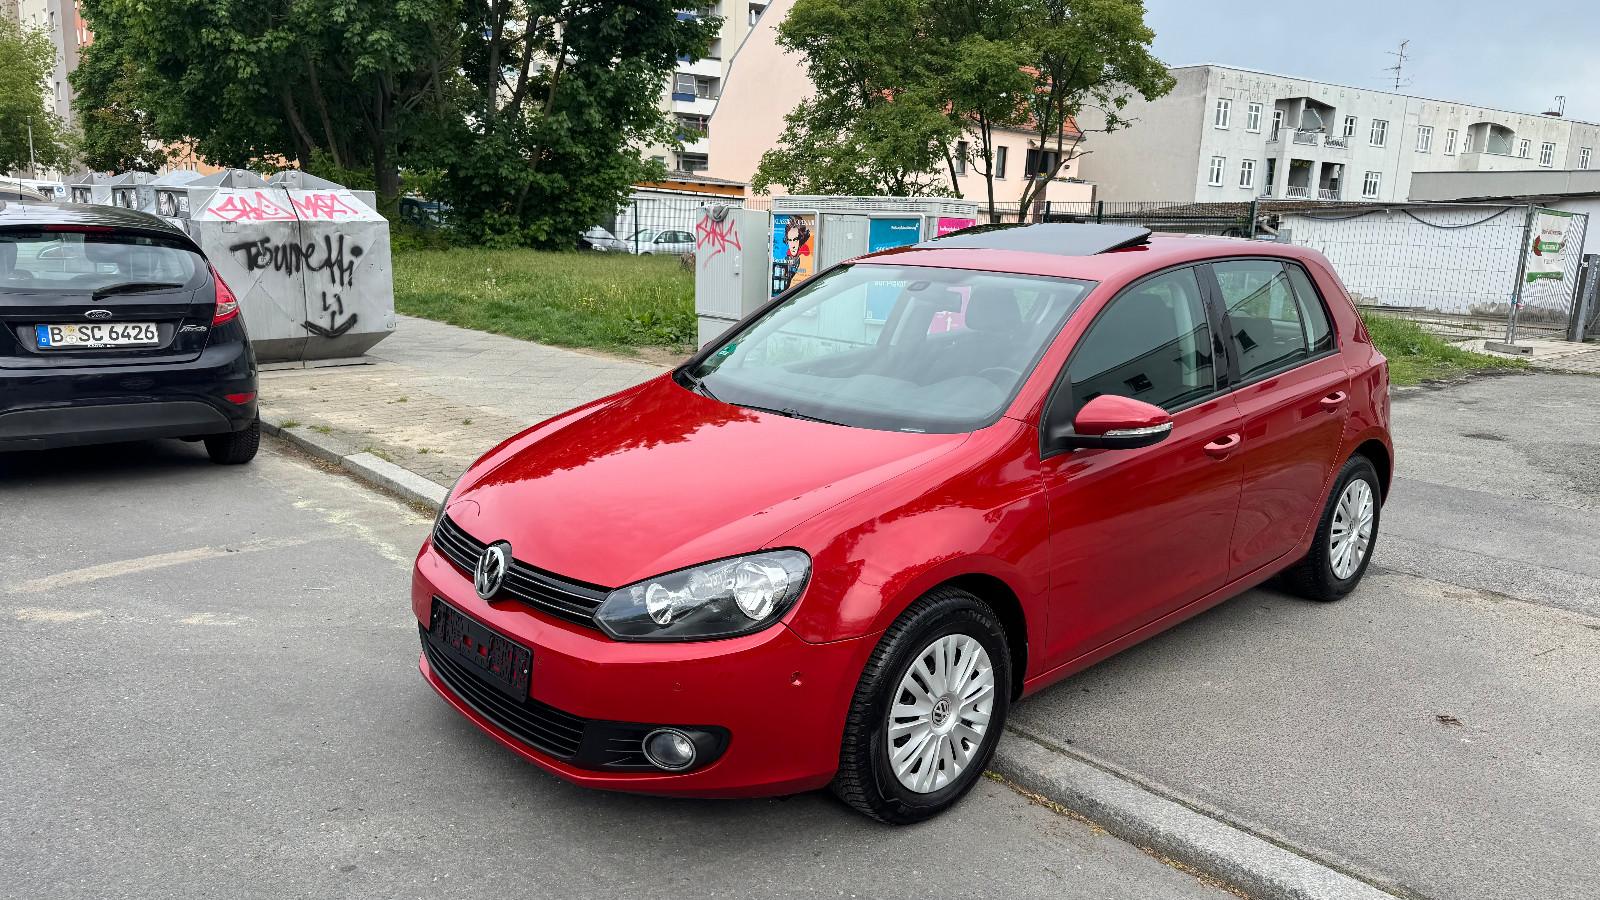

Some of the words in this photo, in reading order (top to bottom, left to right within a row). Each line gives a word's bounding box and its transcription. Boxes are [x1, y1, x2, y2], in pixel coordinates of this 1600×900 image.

[50, 326, 64, 343] B
[77, 325, 104, 342] SC
[108, 324, 155, 341] 6426
